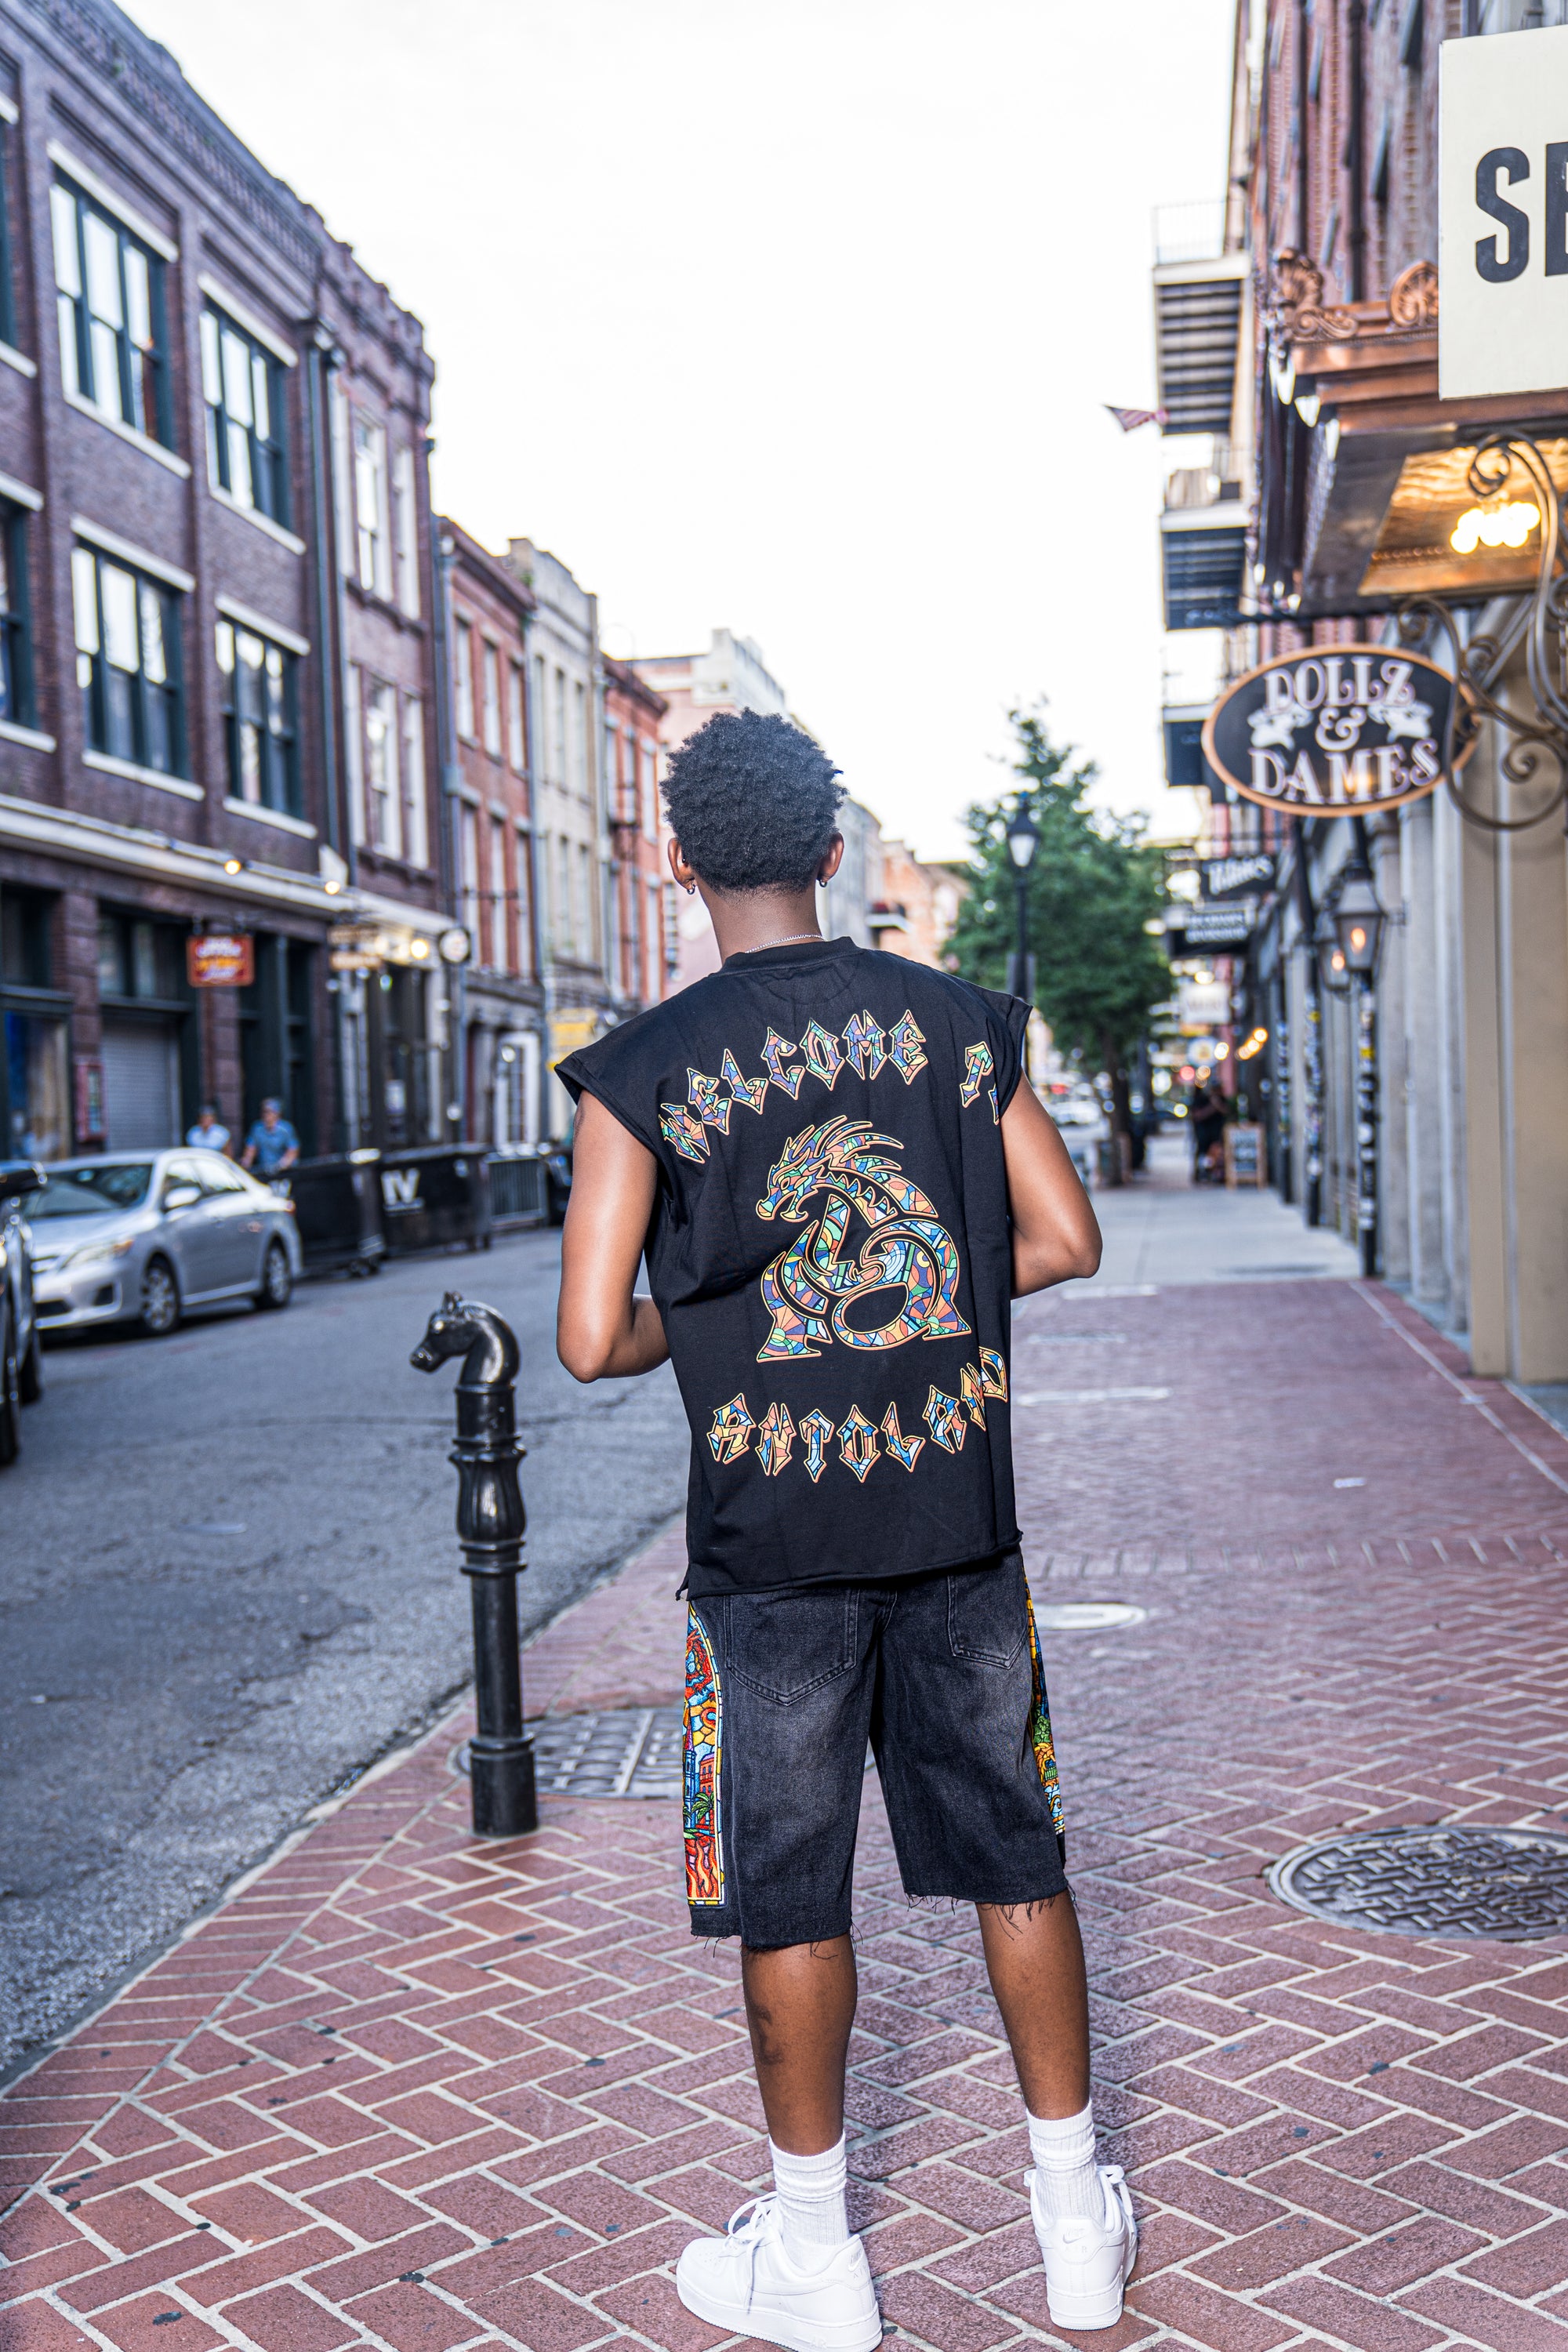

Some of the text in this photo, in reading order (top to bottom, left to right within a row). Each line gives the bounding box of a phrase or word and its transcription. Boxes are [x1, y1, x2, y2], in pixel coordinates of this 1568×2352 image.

[1263, 655, 1416, 715] DOLLZ
[1315, 706, 1367, 752] &
[1247, 738, 1440, 805] DAMES
[658, 1008, 1000, 1164] WELCOME T
[706, 1345, 1008, 1483] ANTOLAND
